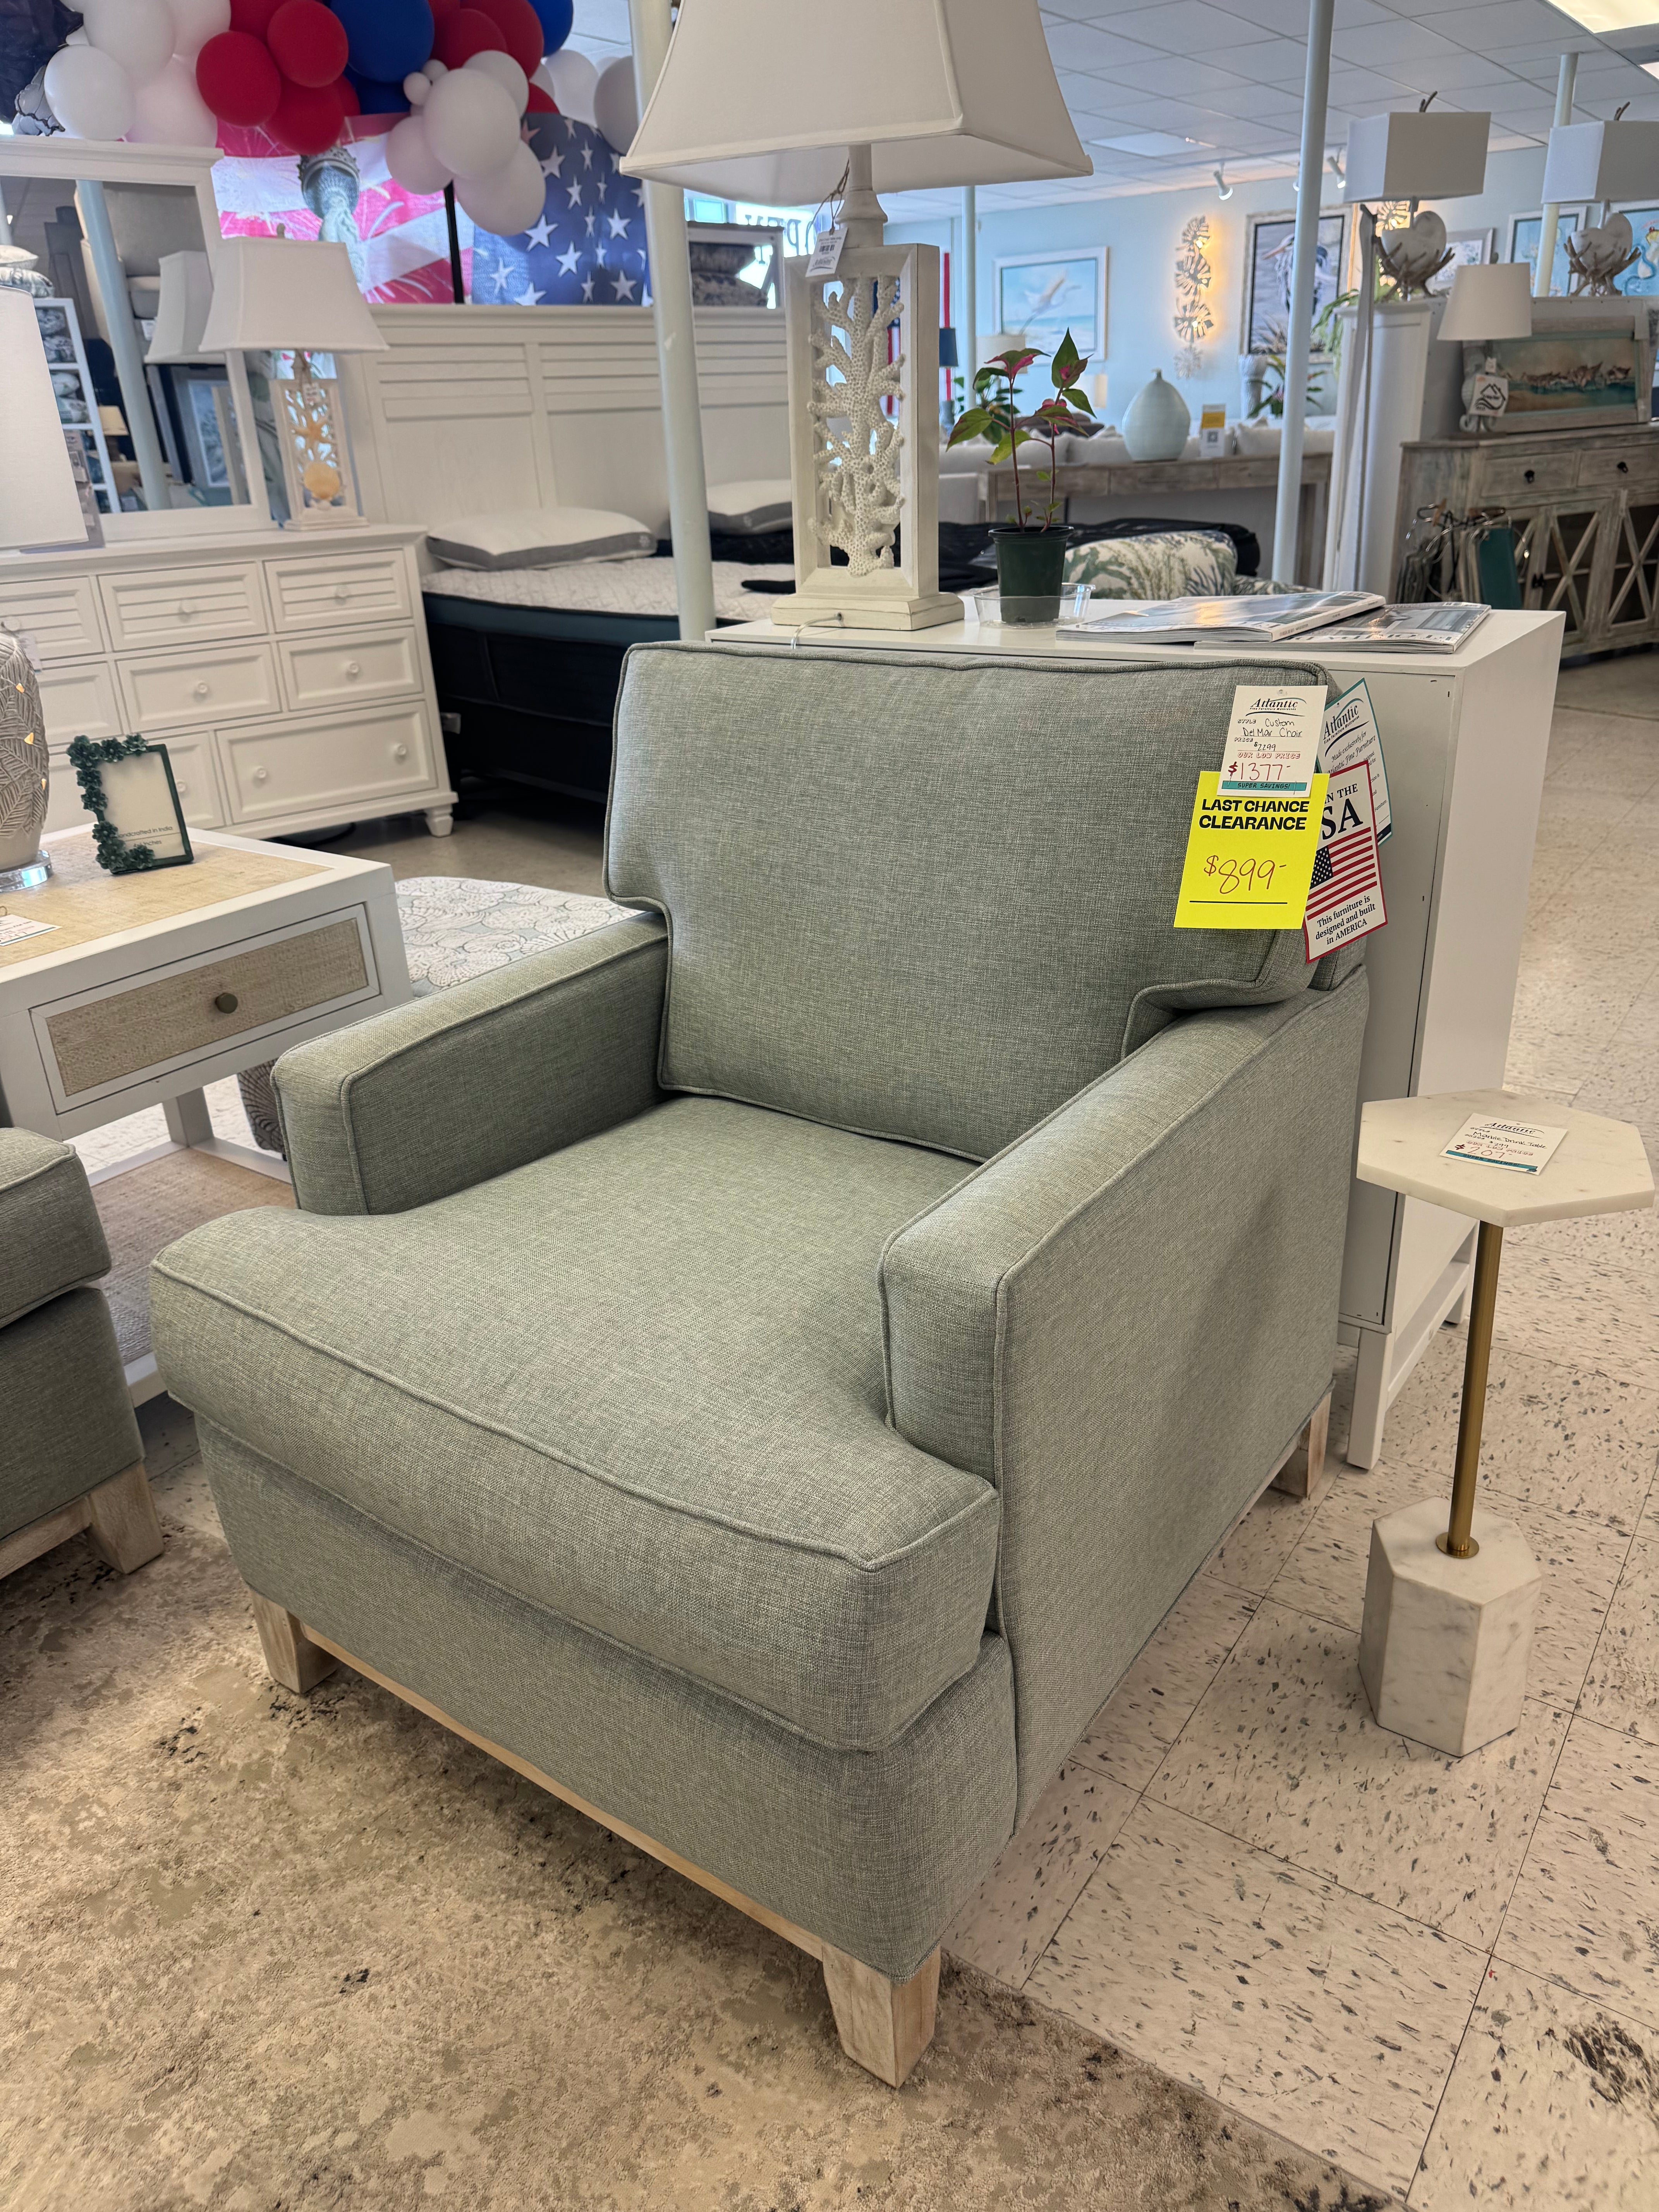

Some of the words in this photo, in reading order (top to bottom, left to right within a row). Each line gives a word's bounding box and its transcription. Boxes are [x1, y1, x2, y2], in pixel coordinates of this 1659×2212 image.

[1250, 698, 1298, 708] Atlantic
[1265, 718, 1294, 727] Custom
[1323, 705, 1358, 740] Atlantic
[1279, 727, 1302, 737] Chair
[1254, 742, 1276, 751] $2299
[1345, 752, 1355, 765] Fine
[1356, 735, 1376, 757] Furniture
[1332, 750, 1342, 762] Made
[1337, 783, 1358, 798] THE
[1202, 799, 1242, 812] LAST
[1244, 800, 1310, 812] CHANCE
[1199, 815, 1307, 830] CLEARANCE
[1321, 798, 1364, 840] SA
[118, 829, 151, 838] andcrafted
[1317, 915, 1332, 927] This
[1333, 900, 1363, 919] furniture
[1364, 895, 1370, 903] is
[1316, 919, 1345, 940] designed
[1346, 911, 1358, 924] and
[1360, 903, 1376, 917] built
[1335, 918, 1368, 941] AMERICA
[1473, 1132, 1502, 1140] Marble
